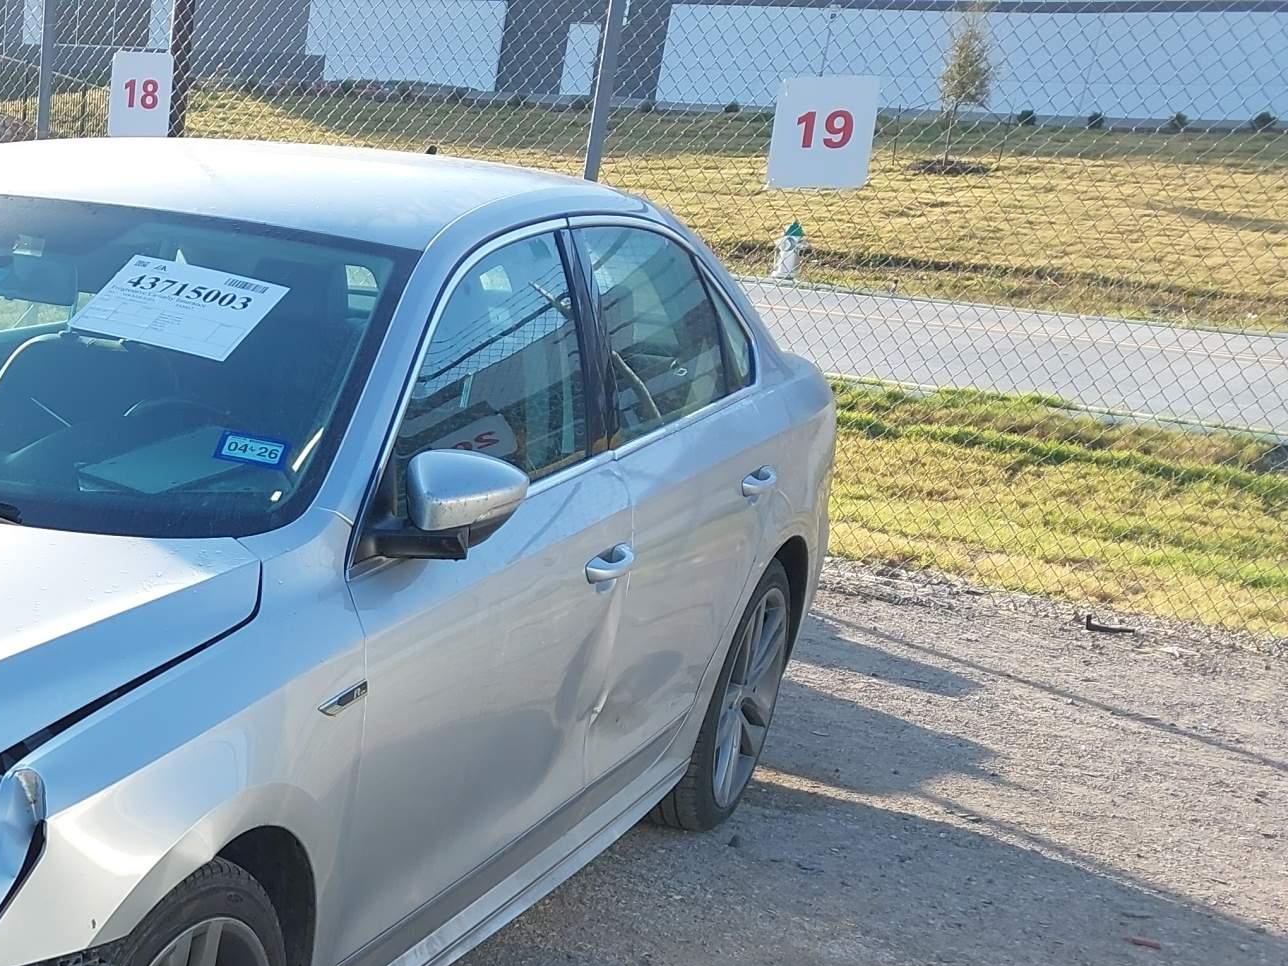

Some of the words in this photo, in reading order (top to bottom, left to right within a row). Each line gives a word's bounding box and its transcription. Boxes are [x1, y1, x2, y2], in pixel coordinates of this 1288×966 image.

[124, 79, 159, 110] 18
[797, 110, 854, 149] 19
[127, 274, 253, 310] 43715003
